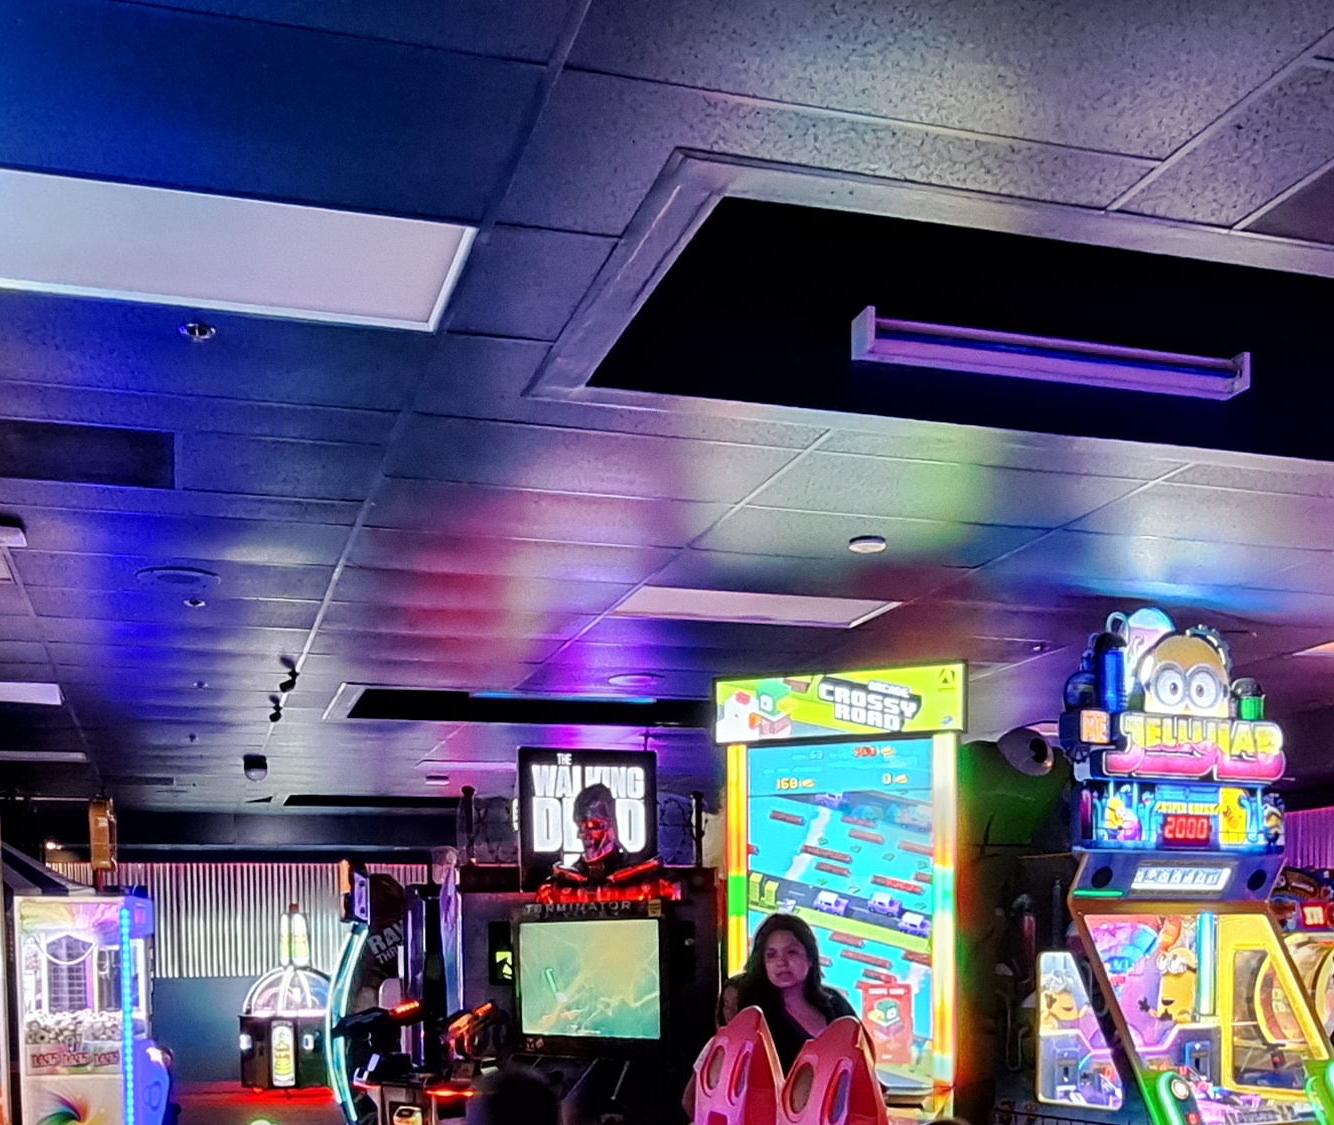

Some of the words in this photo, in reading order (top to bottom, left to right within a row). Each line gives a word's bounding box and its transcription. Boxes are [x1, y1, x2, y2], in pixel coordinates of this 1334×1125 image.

[819, 682, 918, 719] CROSSY
[868, 680, 910, 698] ARCADE
[834, 703, 901, 732] ROAD
[556, 752, 573, 766] THE
[531, 764, 646, 799] WALKING
[1164, 815, 1211, 841] 2000
[525, 900, 631, 913] TERMINATOR
